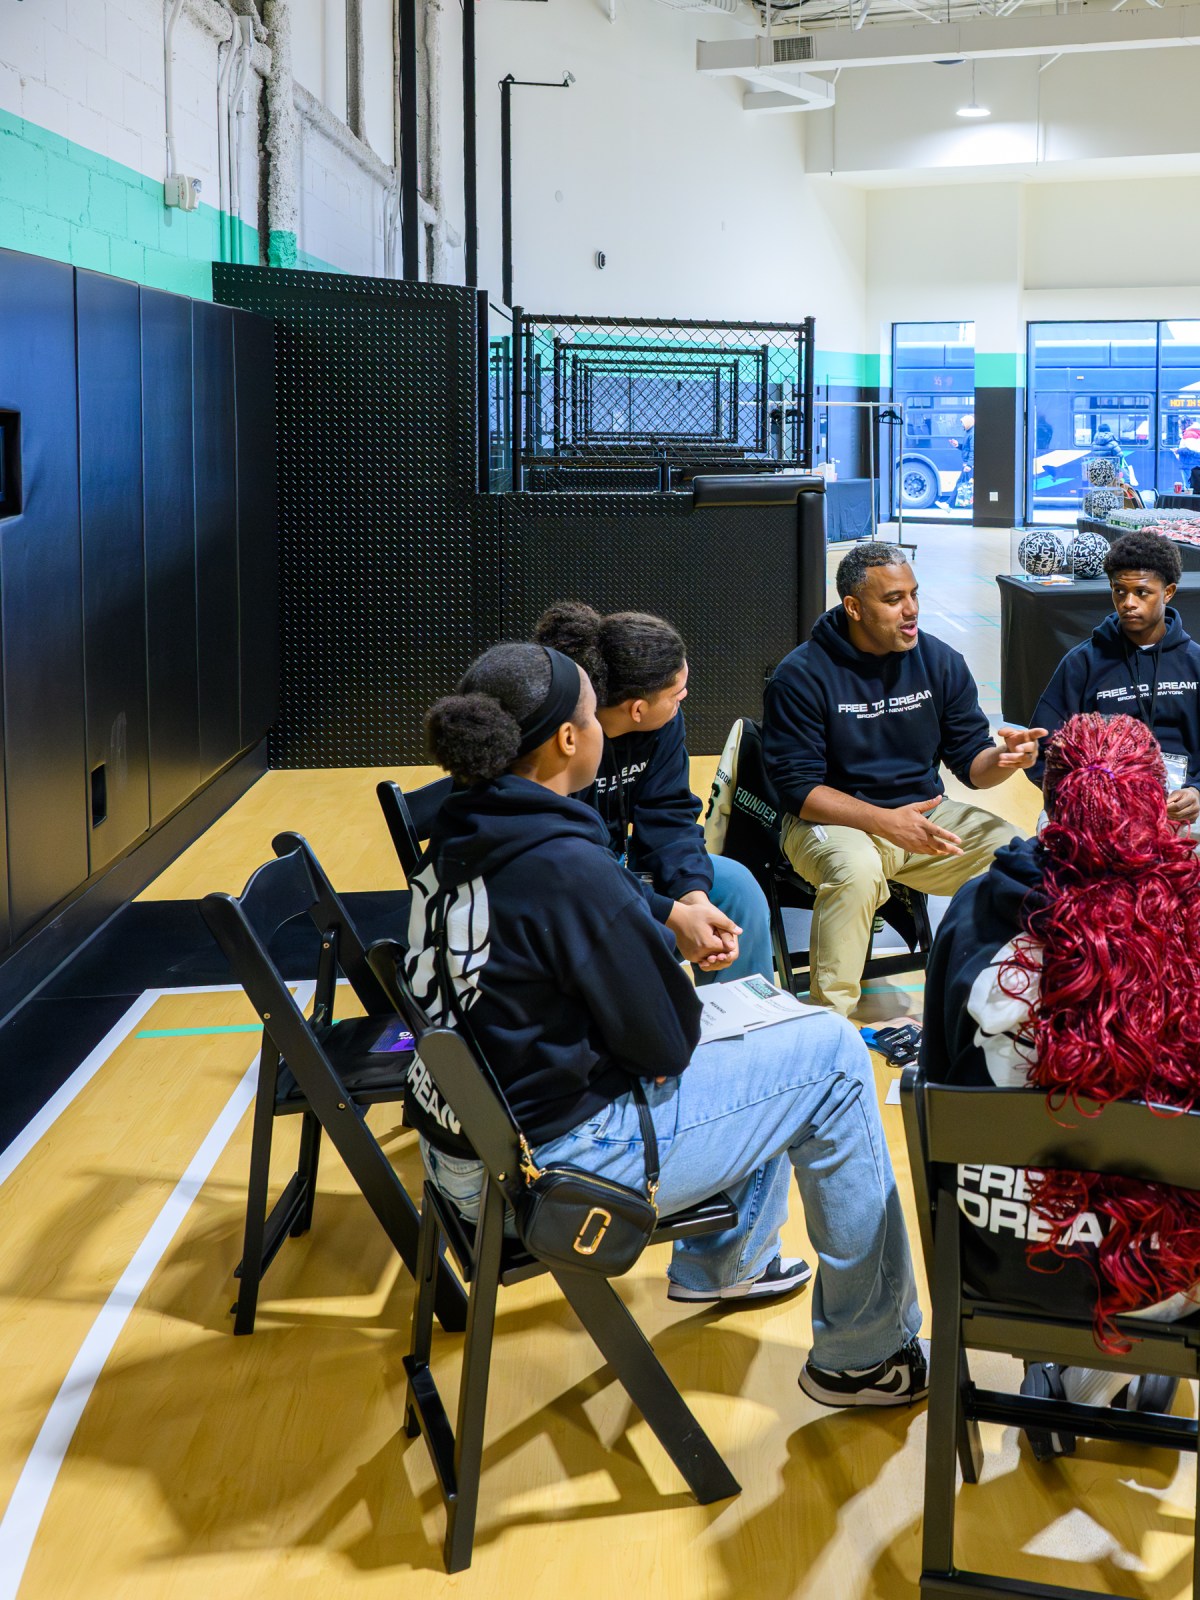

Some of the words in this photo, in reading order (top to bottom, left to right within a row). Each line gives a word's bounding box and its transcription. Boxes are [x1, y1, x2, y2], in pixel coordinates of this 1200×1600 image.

[1170, 399, 1184, 407] NOT
[1186, 399, 1196, 407] IN
[838, 703, 868, 713] FREE
[871, 700, 885, 711] TO
[1096, 686, 1128, 701] FREE
[734, 786, 778, 824] FOUNDER
[406, 1050, 463, 1135] REAM
[957, 1187, 1105, 1249] DREA
